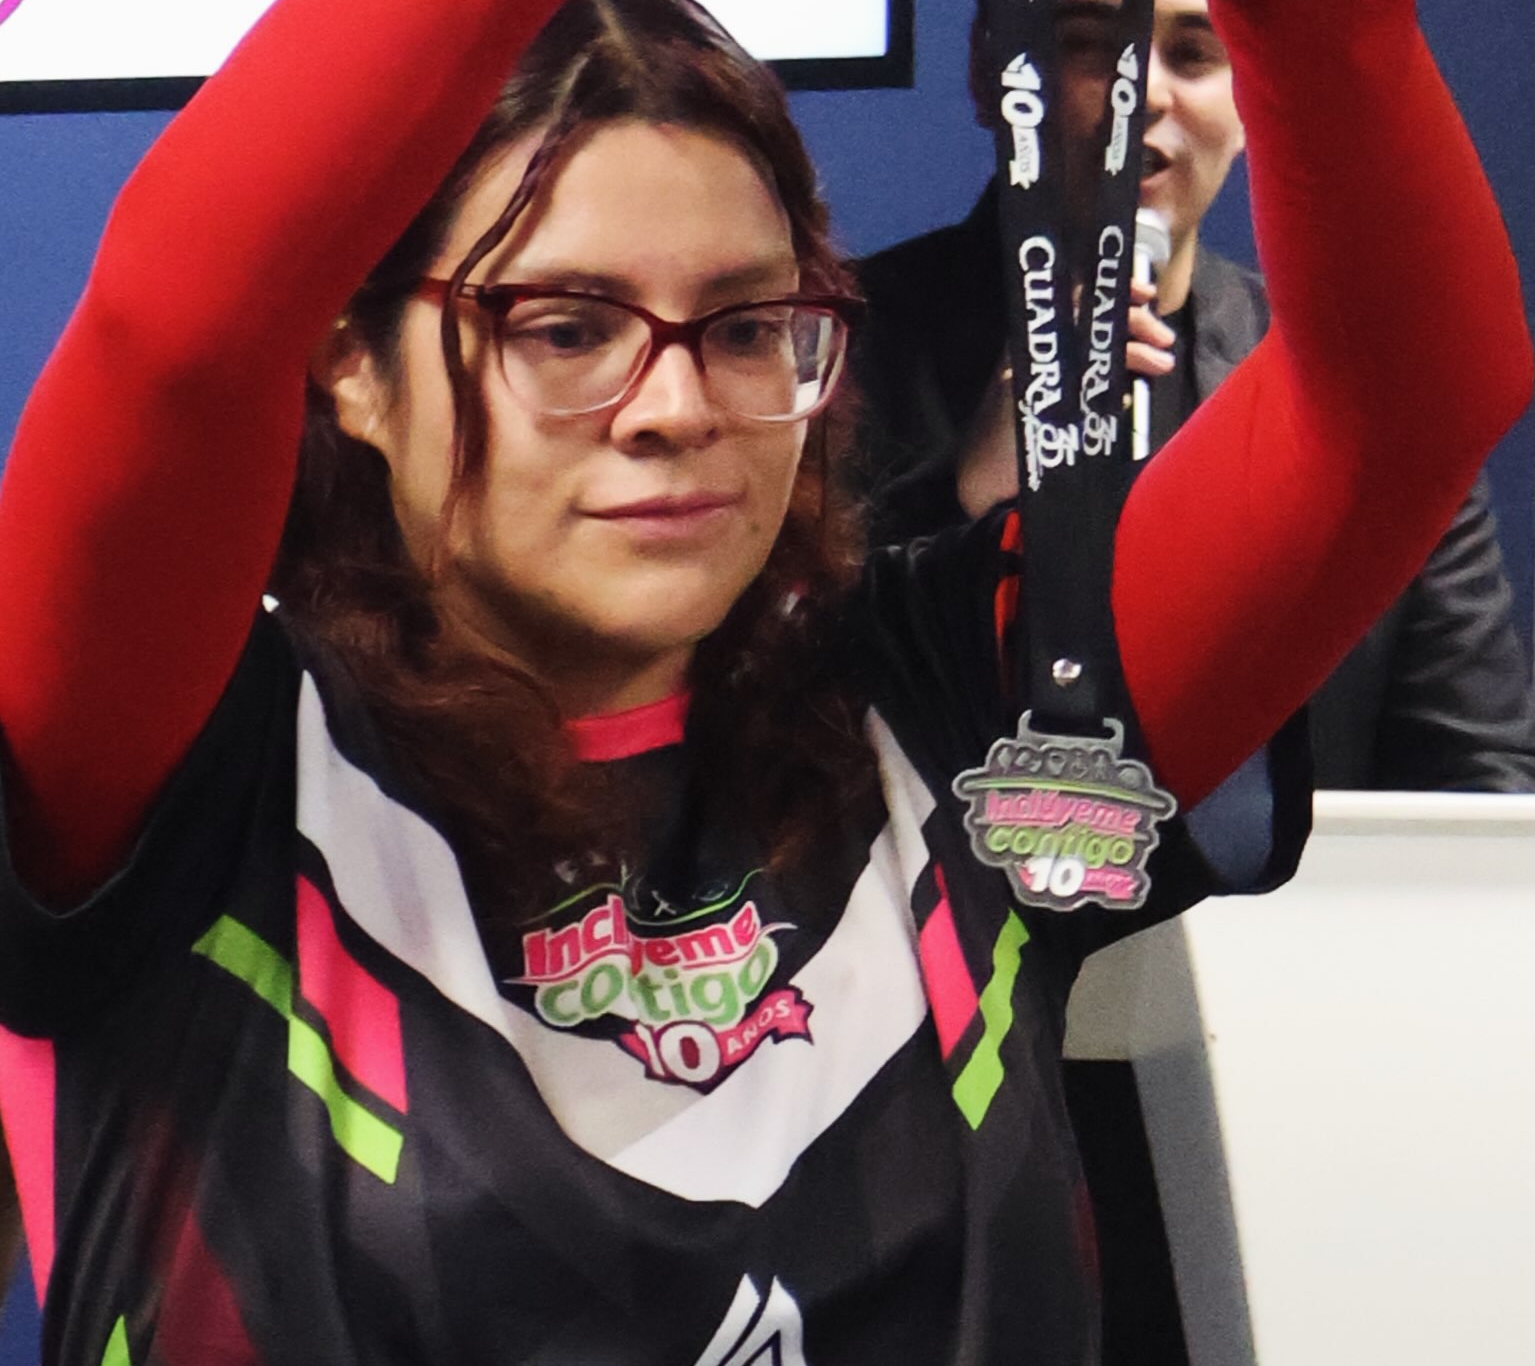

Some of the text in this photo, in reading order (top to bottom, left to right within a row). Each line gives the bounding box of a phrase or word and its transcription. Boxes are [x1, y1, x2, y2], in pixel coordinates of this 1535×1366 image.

[1001, 61, 1044, 129] 10
[1111, 53, 1138, 117] 10
[1019, 236, 1062, 418] CUADRA
[1080, 225, 1124, 414] CUADRA
[1024, 856, 1085, 897] 10
[634, 1019, 720, 1083] 10
